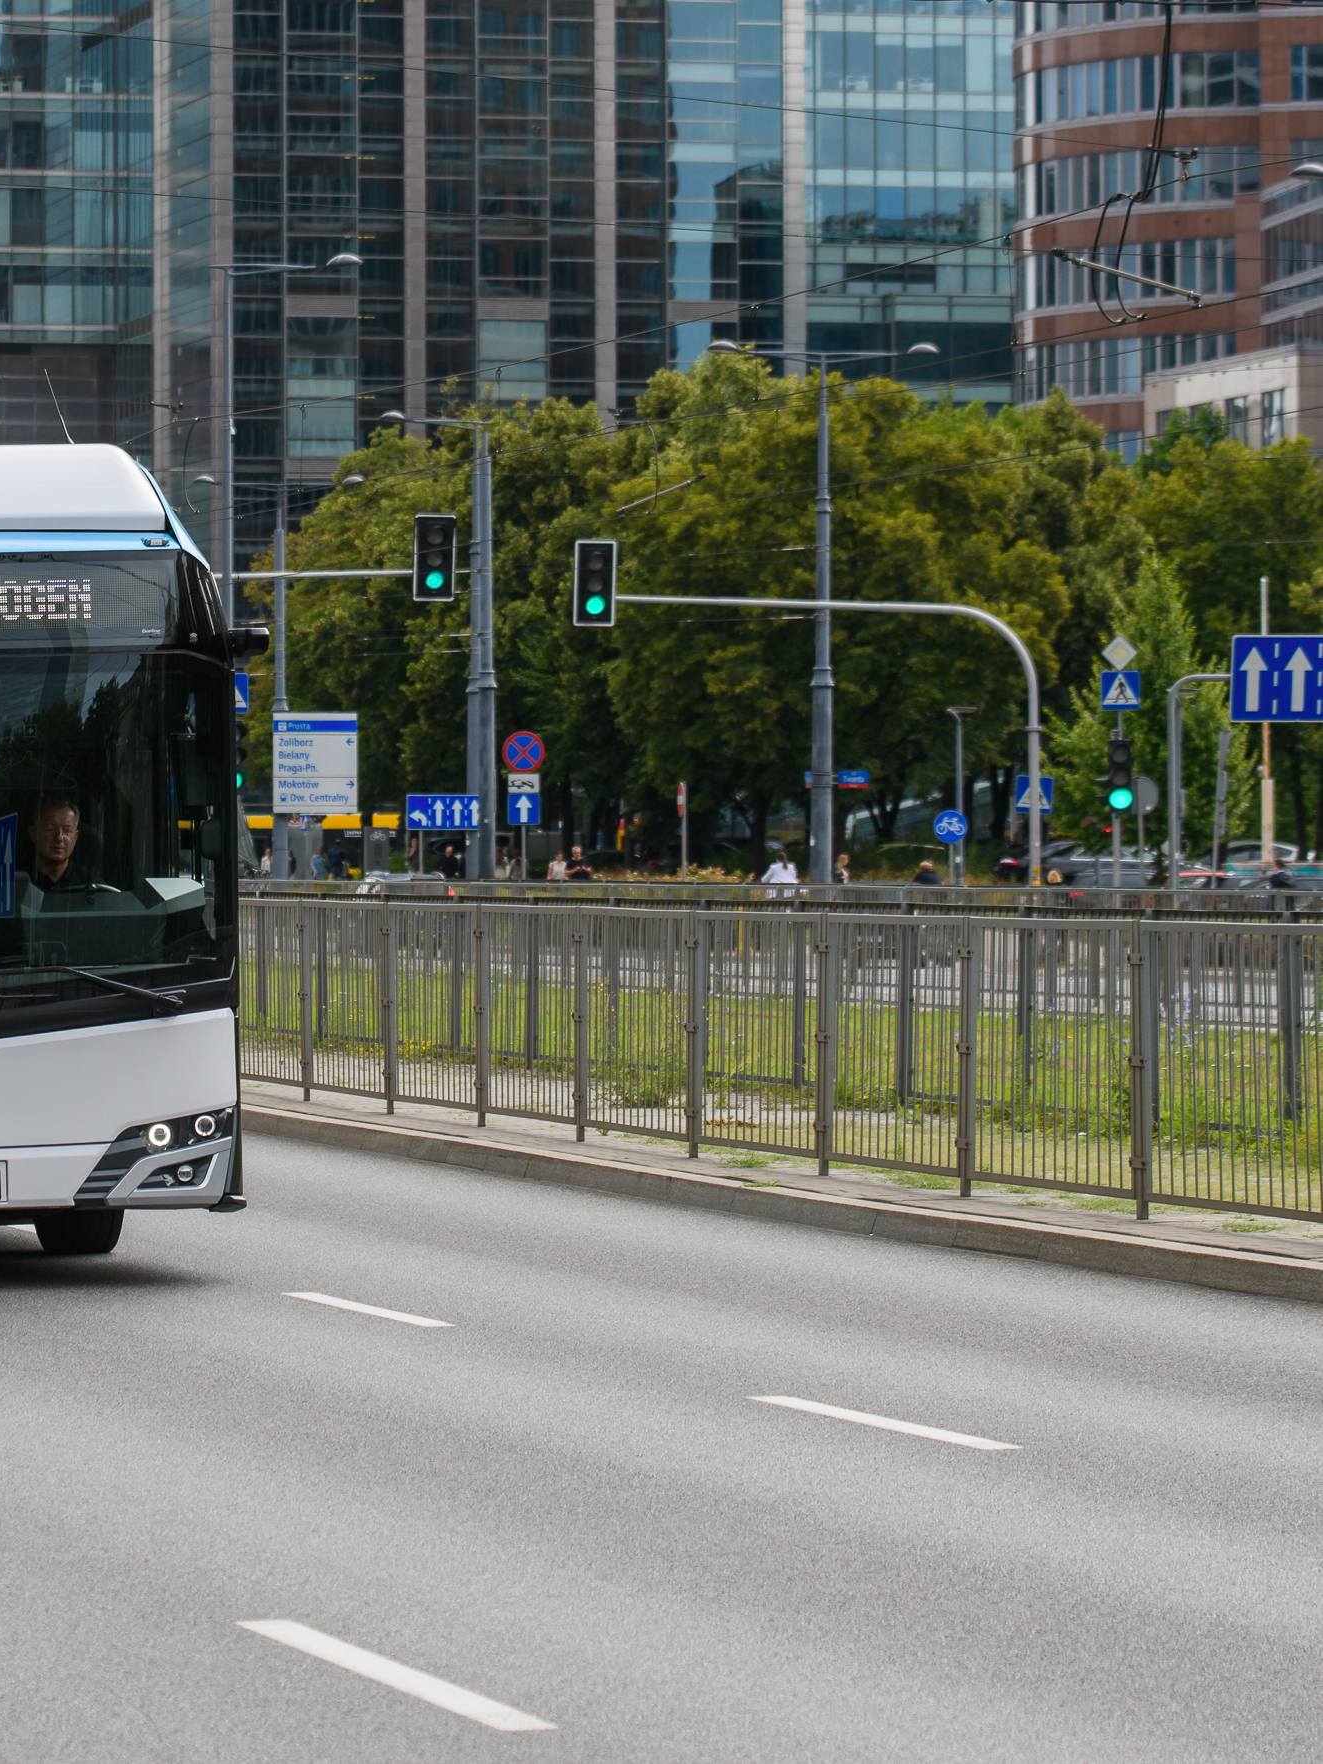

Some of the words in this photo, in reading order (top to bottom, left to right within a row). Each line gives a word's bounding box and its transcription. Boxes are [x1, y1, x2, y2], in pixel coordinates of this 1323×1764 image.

[288, 722, 311, 730] Prosta
[278, 736, 313, 747] Żoliborz
[278, 750, 310, 762] Bielany
[278, 763, 319, 775] Praga-Pn.
[278, 780, 319, 789] Mokotów
[290, 793, 306, 803] Dw.
[309, 793, 349, 805] Centralny
